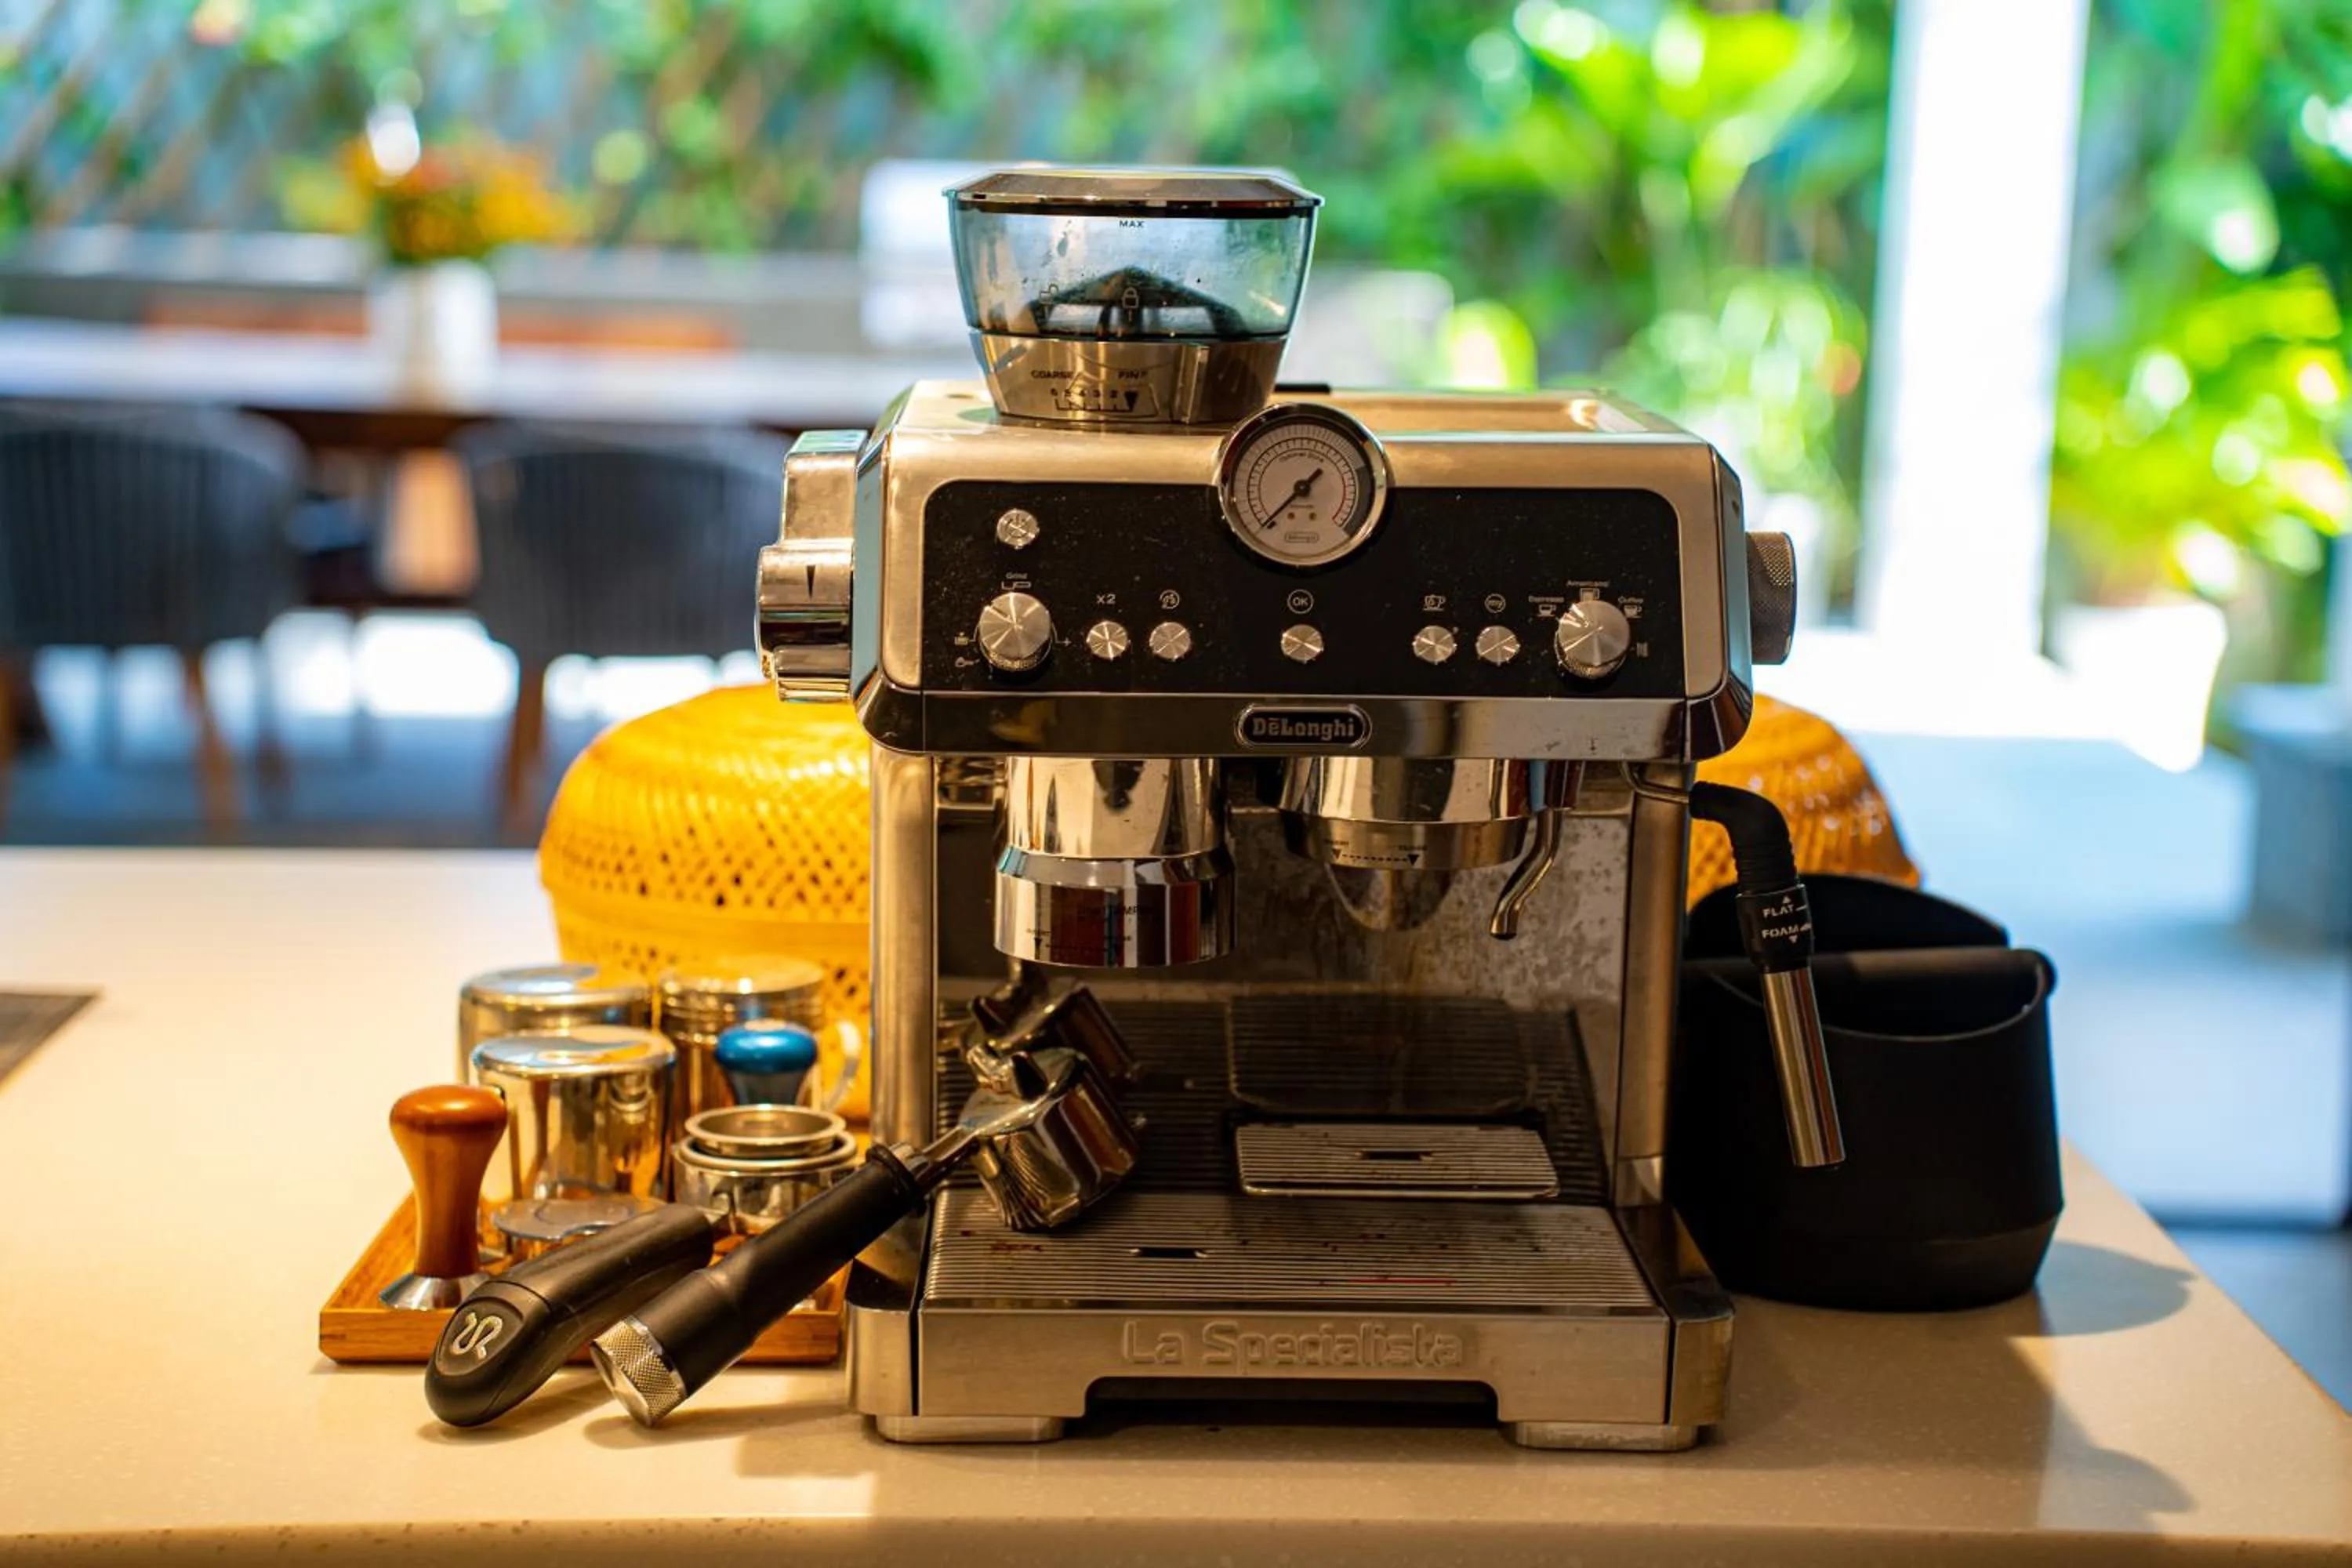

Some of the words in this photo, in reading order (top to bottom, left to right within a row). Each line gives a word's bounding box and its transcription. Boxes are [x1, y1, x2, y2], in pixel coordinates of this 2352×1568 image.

[1119, 220, 1144, 228] MAX
[1293, 597, 1308, 607] OK
[1762, 904, 1795, 918] FLAT
[1762, 924, 1798, 938] FOAM
[1123, 1319, 1184, 1366] La
[1202, 1319, 1462, 1375] Specialista
